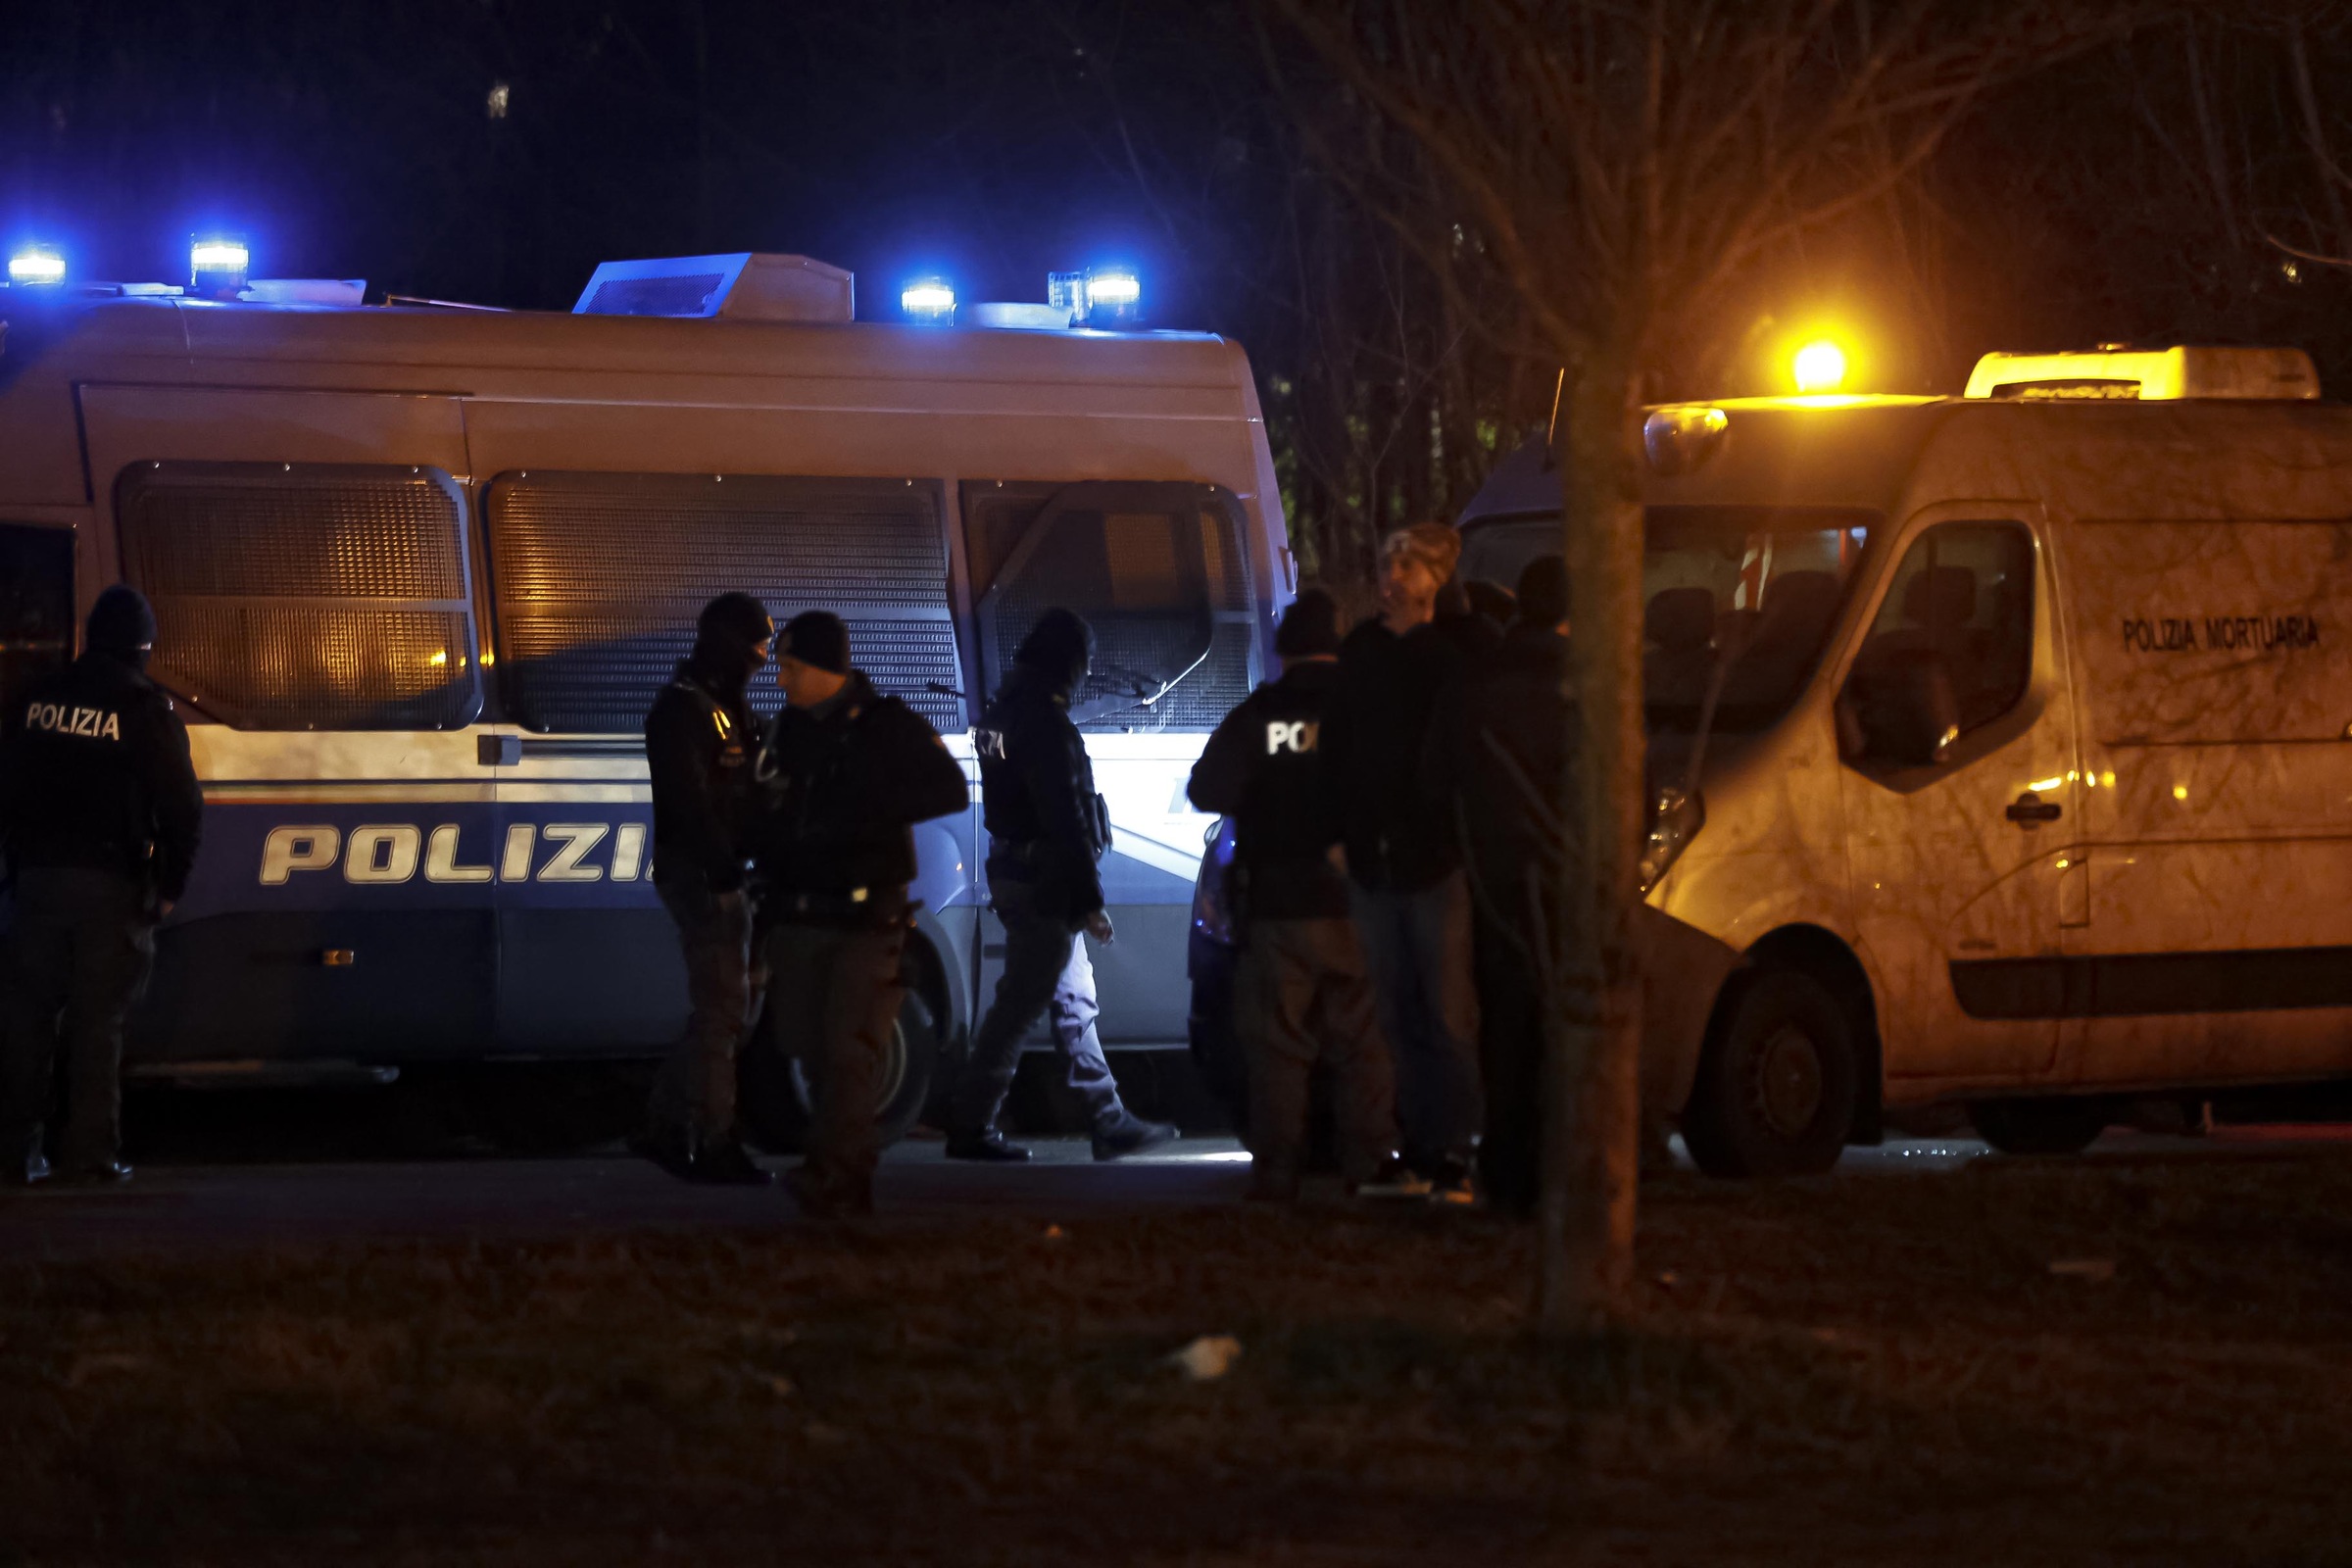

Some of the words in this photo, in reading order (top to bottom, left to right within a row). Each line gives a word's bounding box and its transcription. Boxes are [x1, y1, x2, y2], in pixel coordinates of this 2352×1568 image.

[2123, 618, 2197, 653] POLIZIA
[2206, 616, 2319, 650] MORTUARIA
[26, 701, 122, 742] POLIZIA
[259, 823, 654, 886] POLIZI
